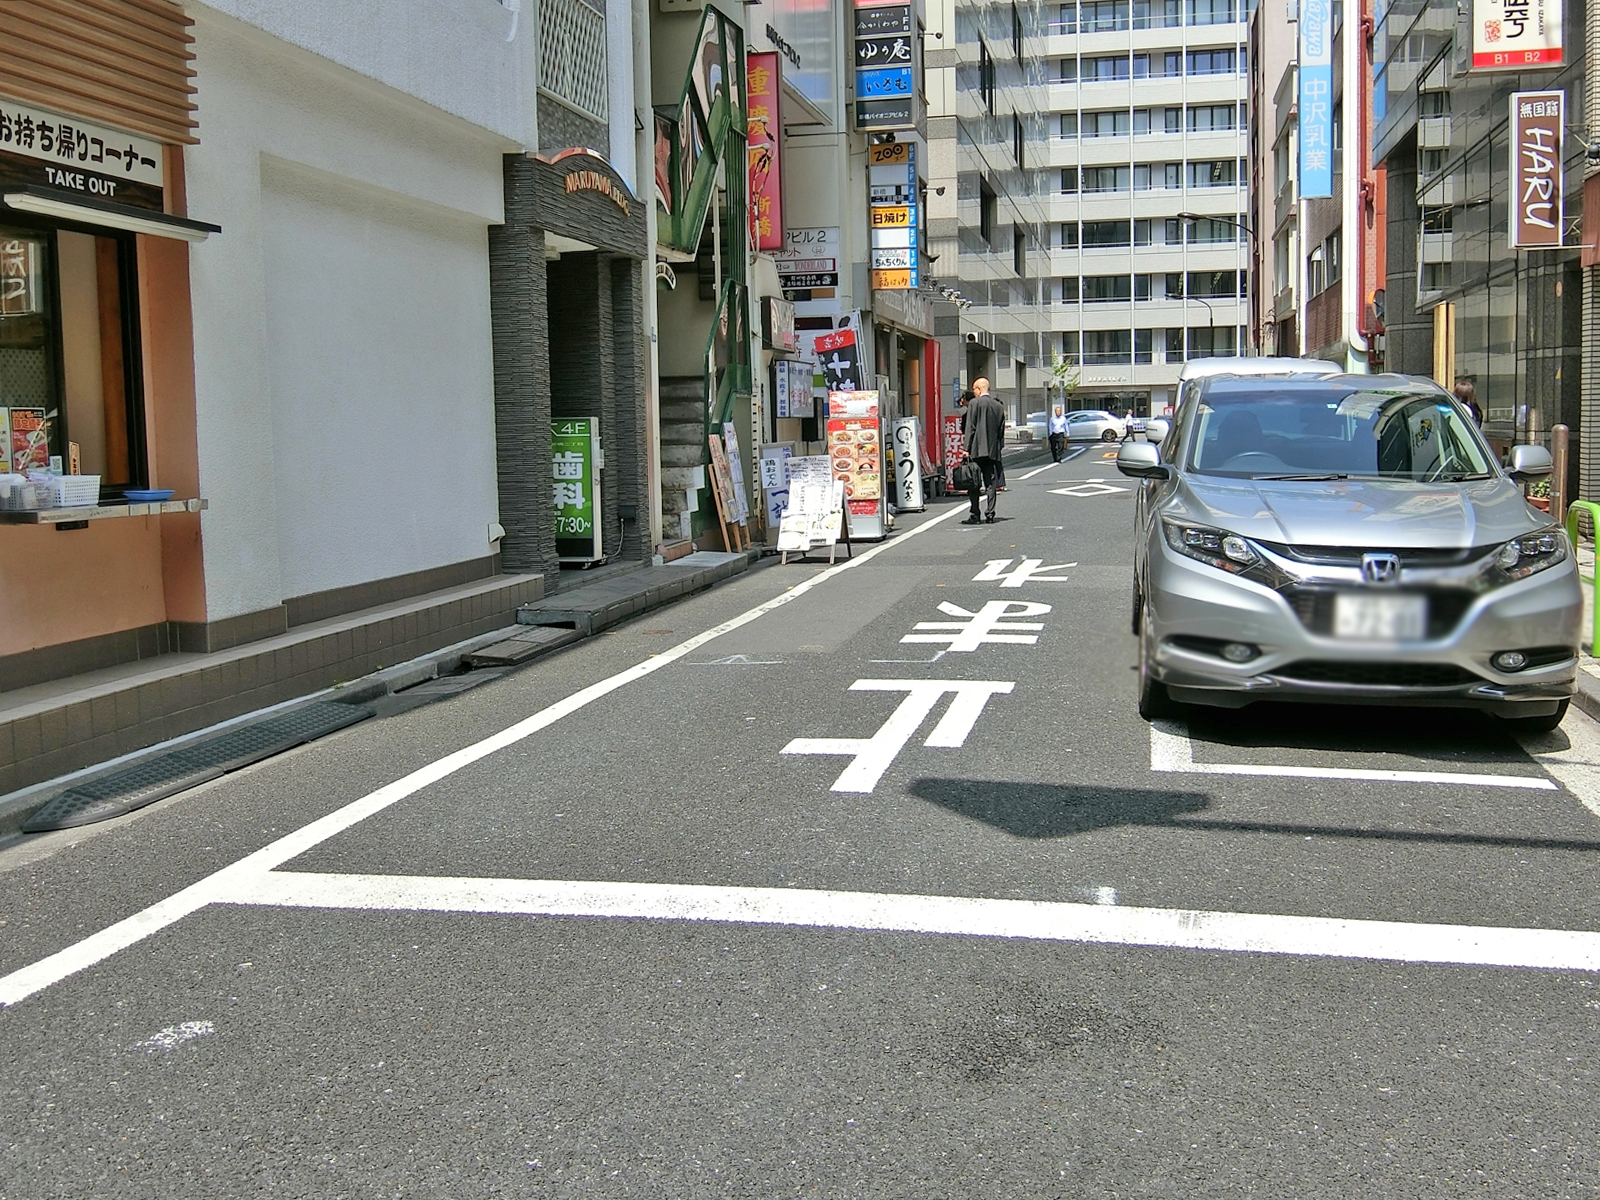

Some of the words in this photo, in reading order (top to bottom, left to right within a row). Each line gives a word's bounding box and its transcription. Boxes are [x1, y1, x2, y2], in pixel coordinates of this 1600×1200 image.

[1494, 53, 1509, 64] B1
[1524, 51, 1541, 62] B2
[866, 77, 908, 93] いさむ
[1520, 101, 1558, 118] 無国籍
[1304, 78, 1328, 171] 中沢乳業
[0, 108, 156, 172] お持ち帰りコーナー
[874, 145, 903, 162] ZOO
[908, 144, 914, 159] 6F
[909, 166, 914, 180] 5F
[1522, 127, 1555, 229] HARU
[45, 166, 85, 190] TAKE
[90, 176, 117, 197] OUT
[909, 187, 914, 202] 4F
[873, 212, 907, 224] 日焼け
[910, 208, 915, 223] 3F
[787, 230, 826, 243] ビル2
[910, 229, 915, 244] 2F
[910, 250, 915, 264] 1F
[910, 271, 917, 285] B1
[561, 422, 587, 434] 4F
[552, 451, 586, 510] 歯科
[764, 459, 778, 487] 鶏おでん
[898, 451, 915, 502] うなぎ
